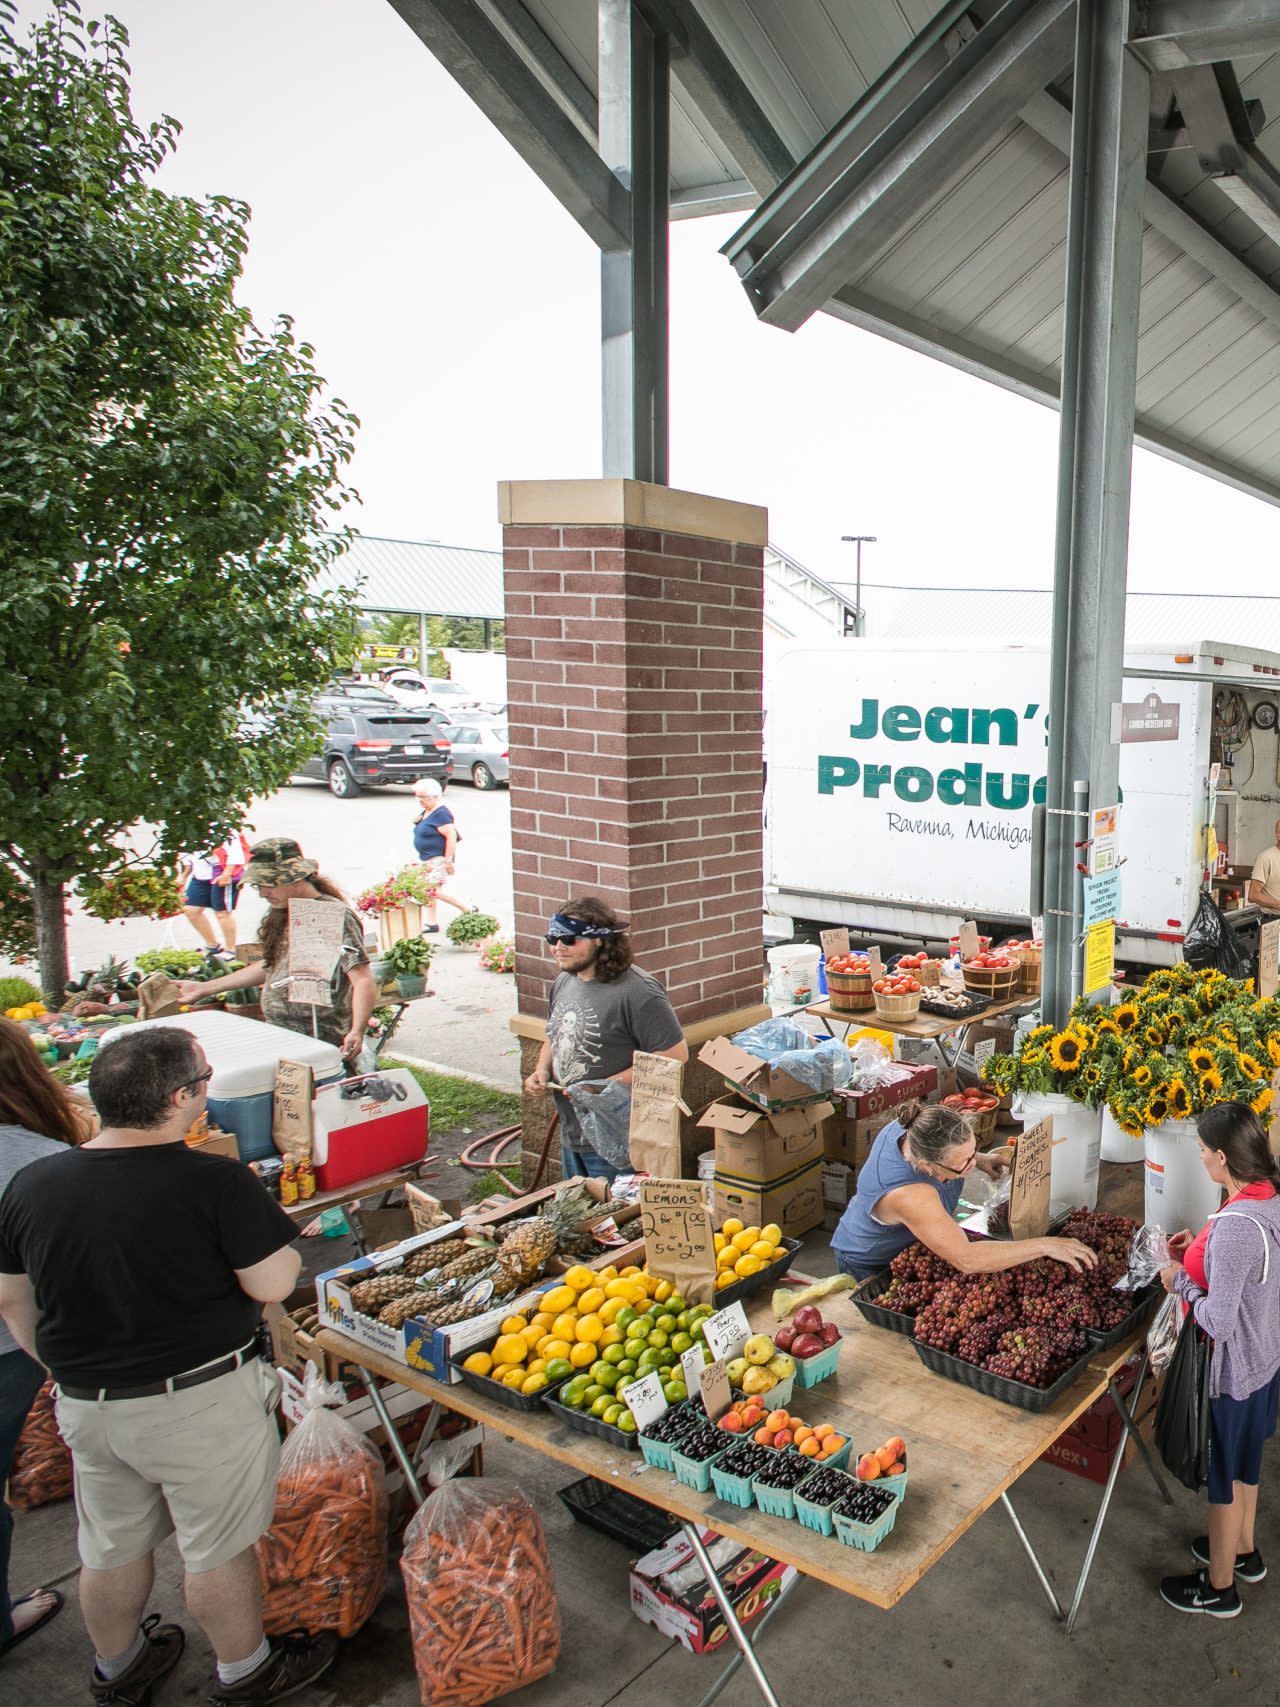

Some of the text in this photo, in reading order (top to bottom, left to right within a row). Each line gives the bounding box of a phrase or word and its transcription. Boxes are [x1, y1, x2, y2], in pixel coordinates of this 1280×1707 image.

[818, 755, 1123, 810] Produ
[886, 812, 955, 839] Ravenna,
[632, 1076, 675, 1096] Pineapples
[1022, 1121, 1045, 1144] SWEET
[640, 1179, 682, 1189] California
[644, 1189, 697, 1204] Lemons
[640, 1211, 661, 1238] 2
[659, 1213, 672, 1224] for
[655, 1243, 665, 1255] 5
